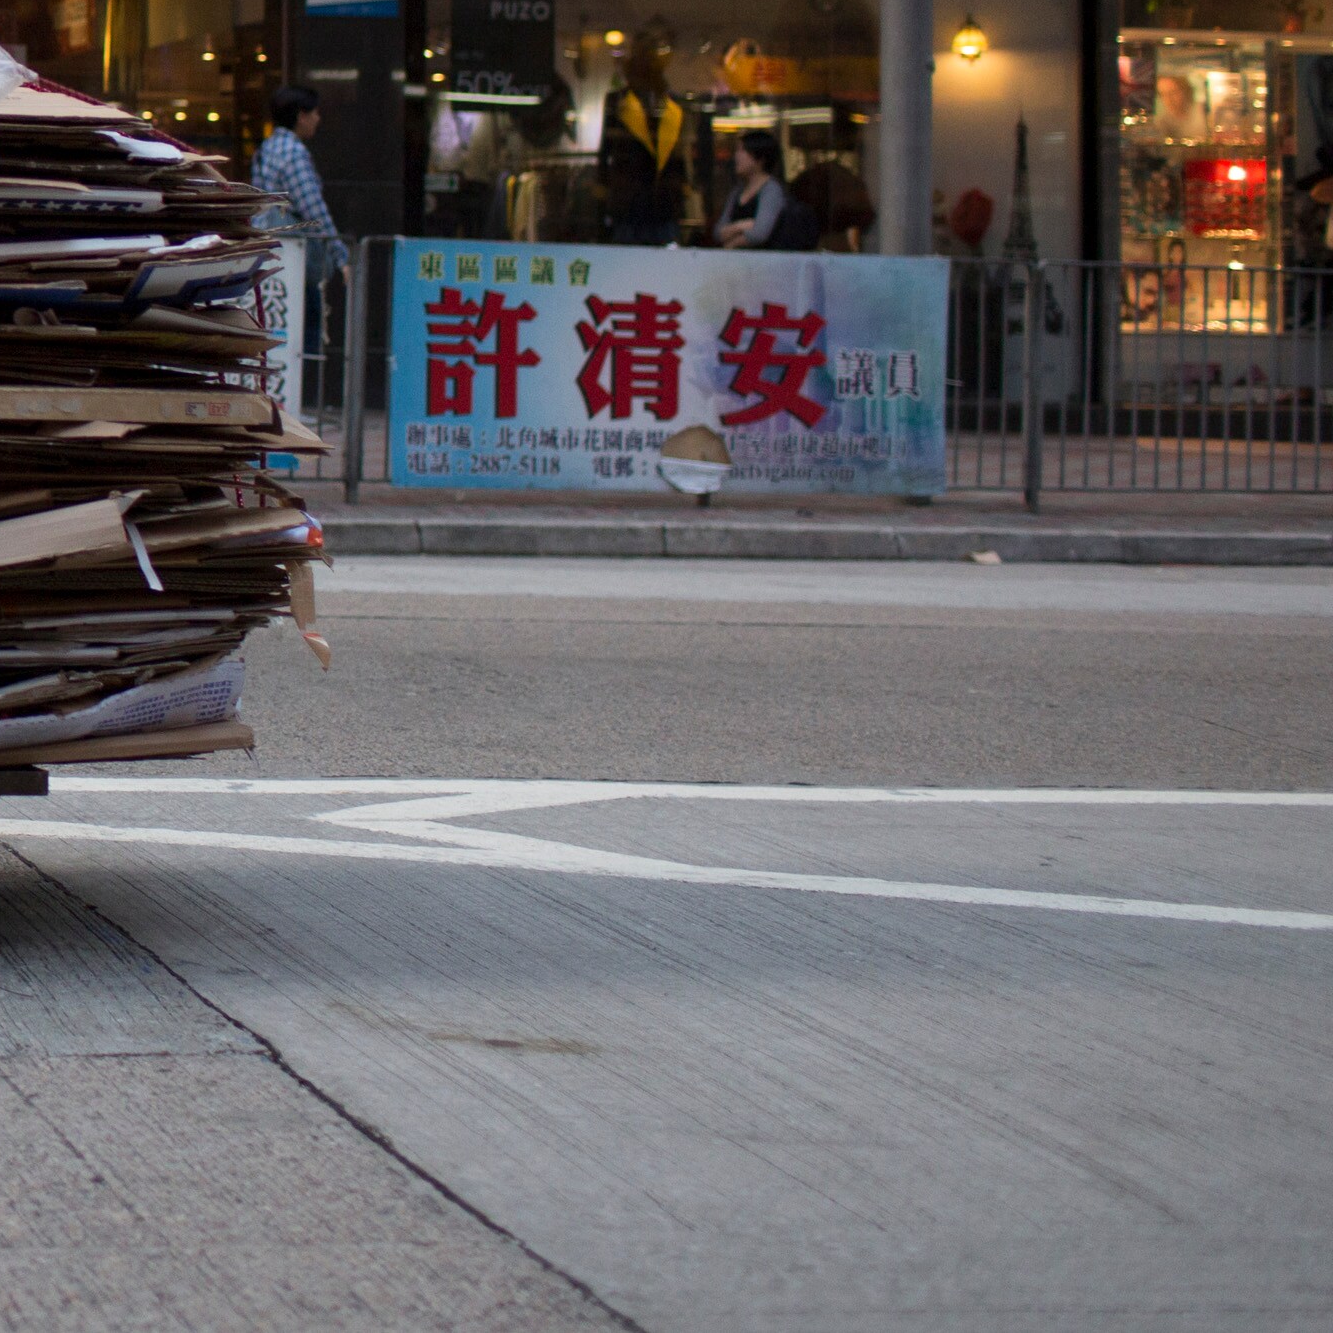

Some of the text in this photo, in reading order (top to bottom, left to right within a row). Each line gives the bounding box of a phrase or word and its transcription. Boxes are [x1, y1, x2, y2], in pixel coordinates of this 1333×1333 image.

[491, 0, 551, 22] PUZO
[418, 251, 591, 287] 東區區議會
[424, 286, 828, 428] 許清安
[836, 346, 920, 400] 議員
